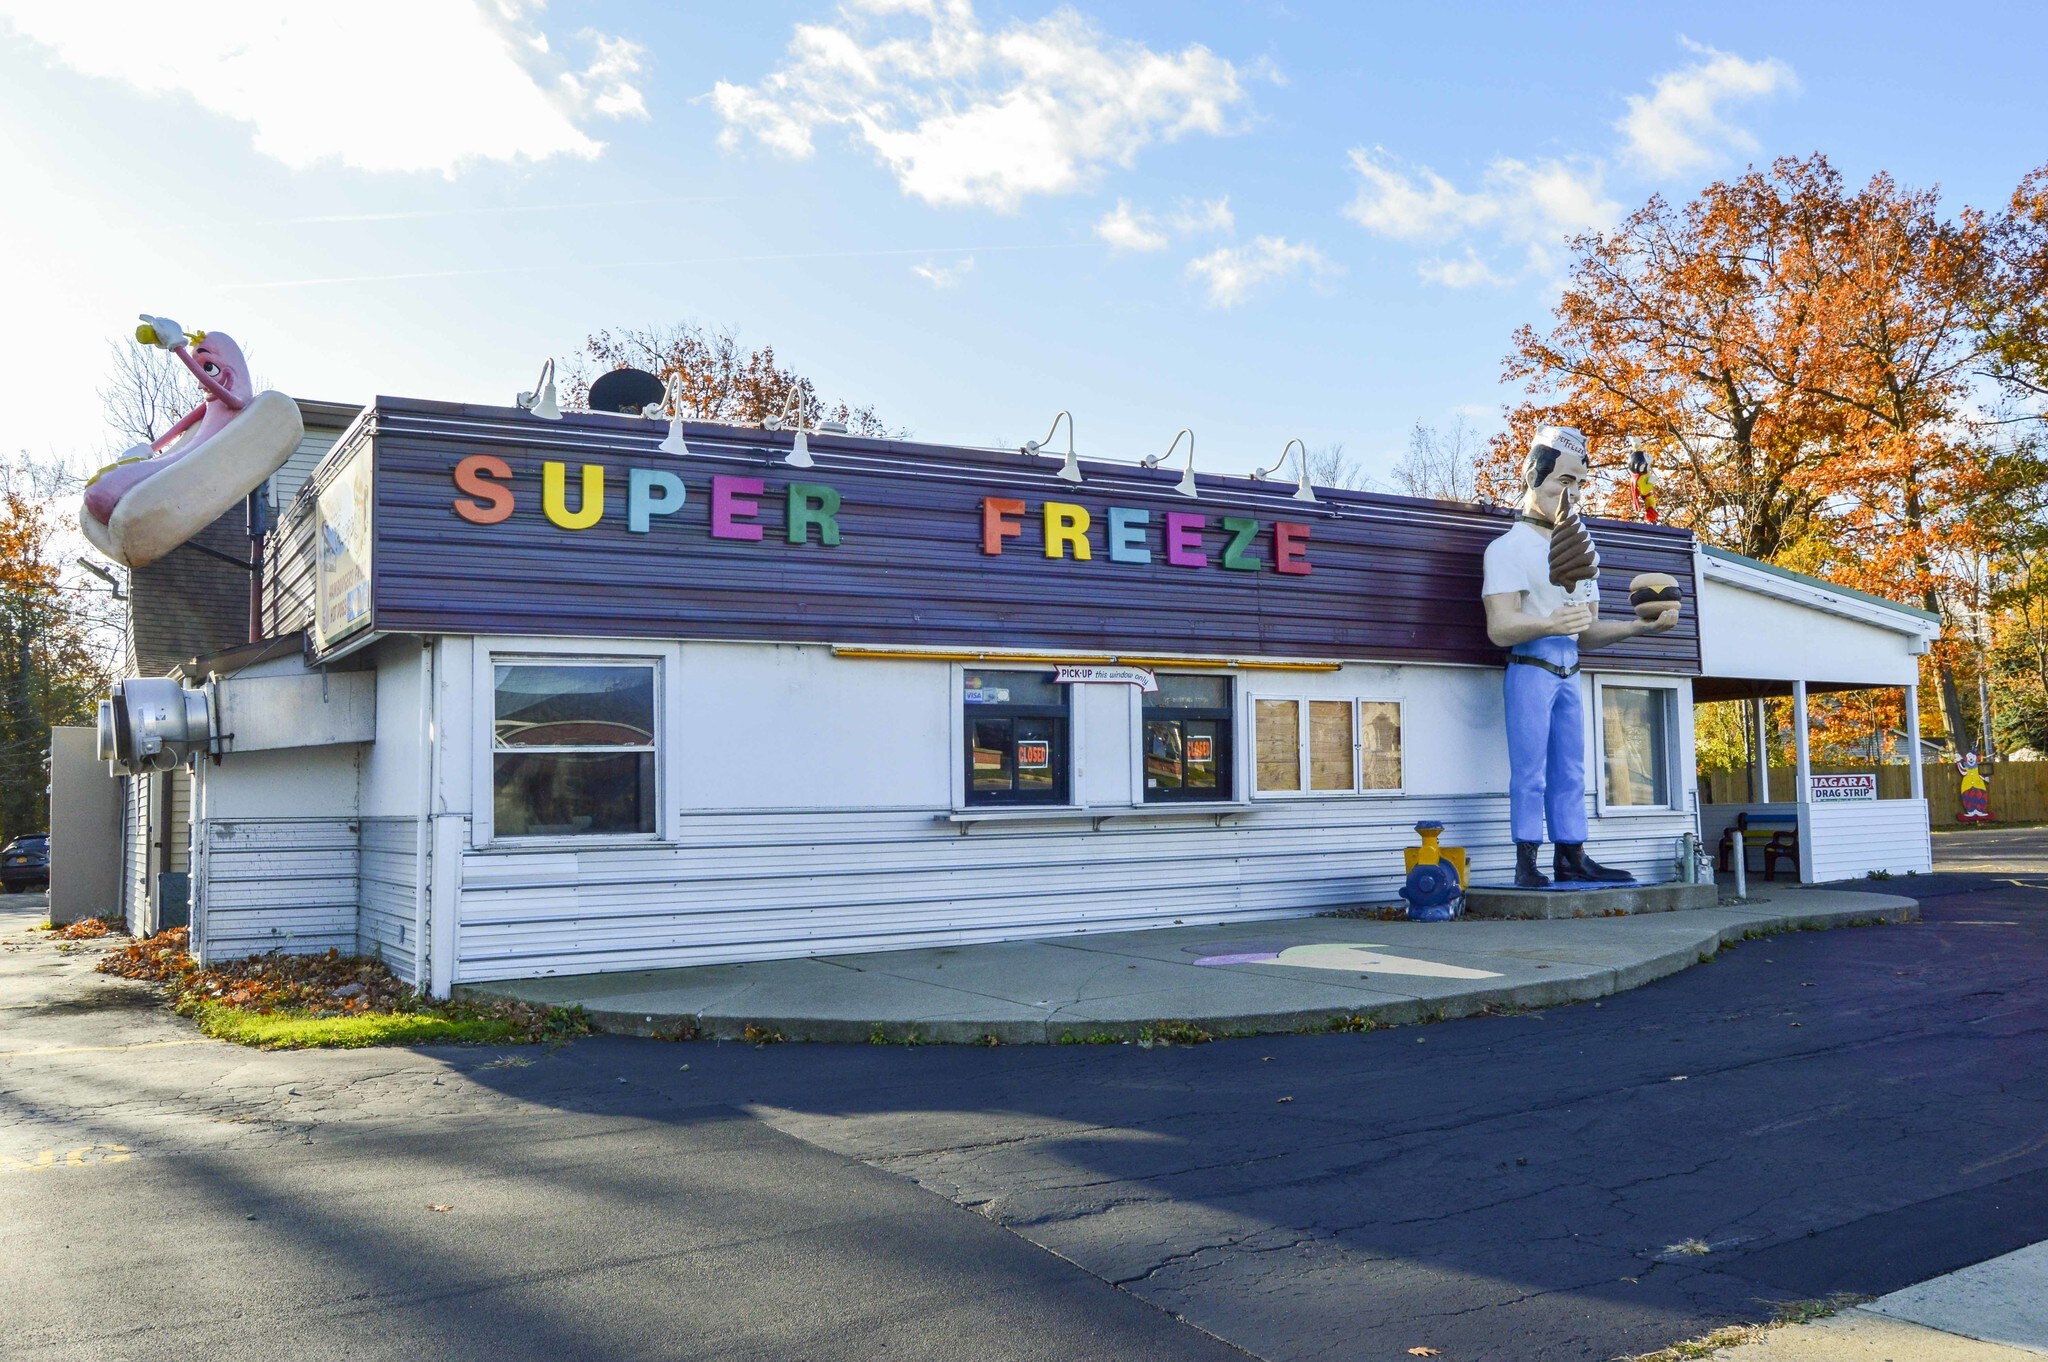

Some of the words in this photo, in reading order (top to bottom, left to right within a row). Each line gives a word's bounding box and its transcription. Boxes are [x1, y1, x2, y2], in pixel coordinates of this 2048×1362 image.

[453, 454, 841, 546] SUPER
[983, 497, 1312, 576] FREEZE
[1095, 670, 1107, 679] this
[1109, 670, 1133, 679] window
[1134, 673, 1149, 686] only
[1018, 746, 1046, 763] CLOSED
[1187, 741, 1210, 758] CLOSED
[1815, 789, 1840, 798] DRAG
